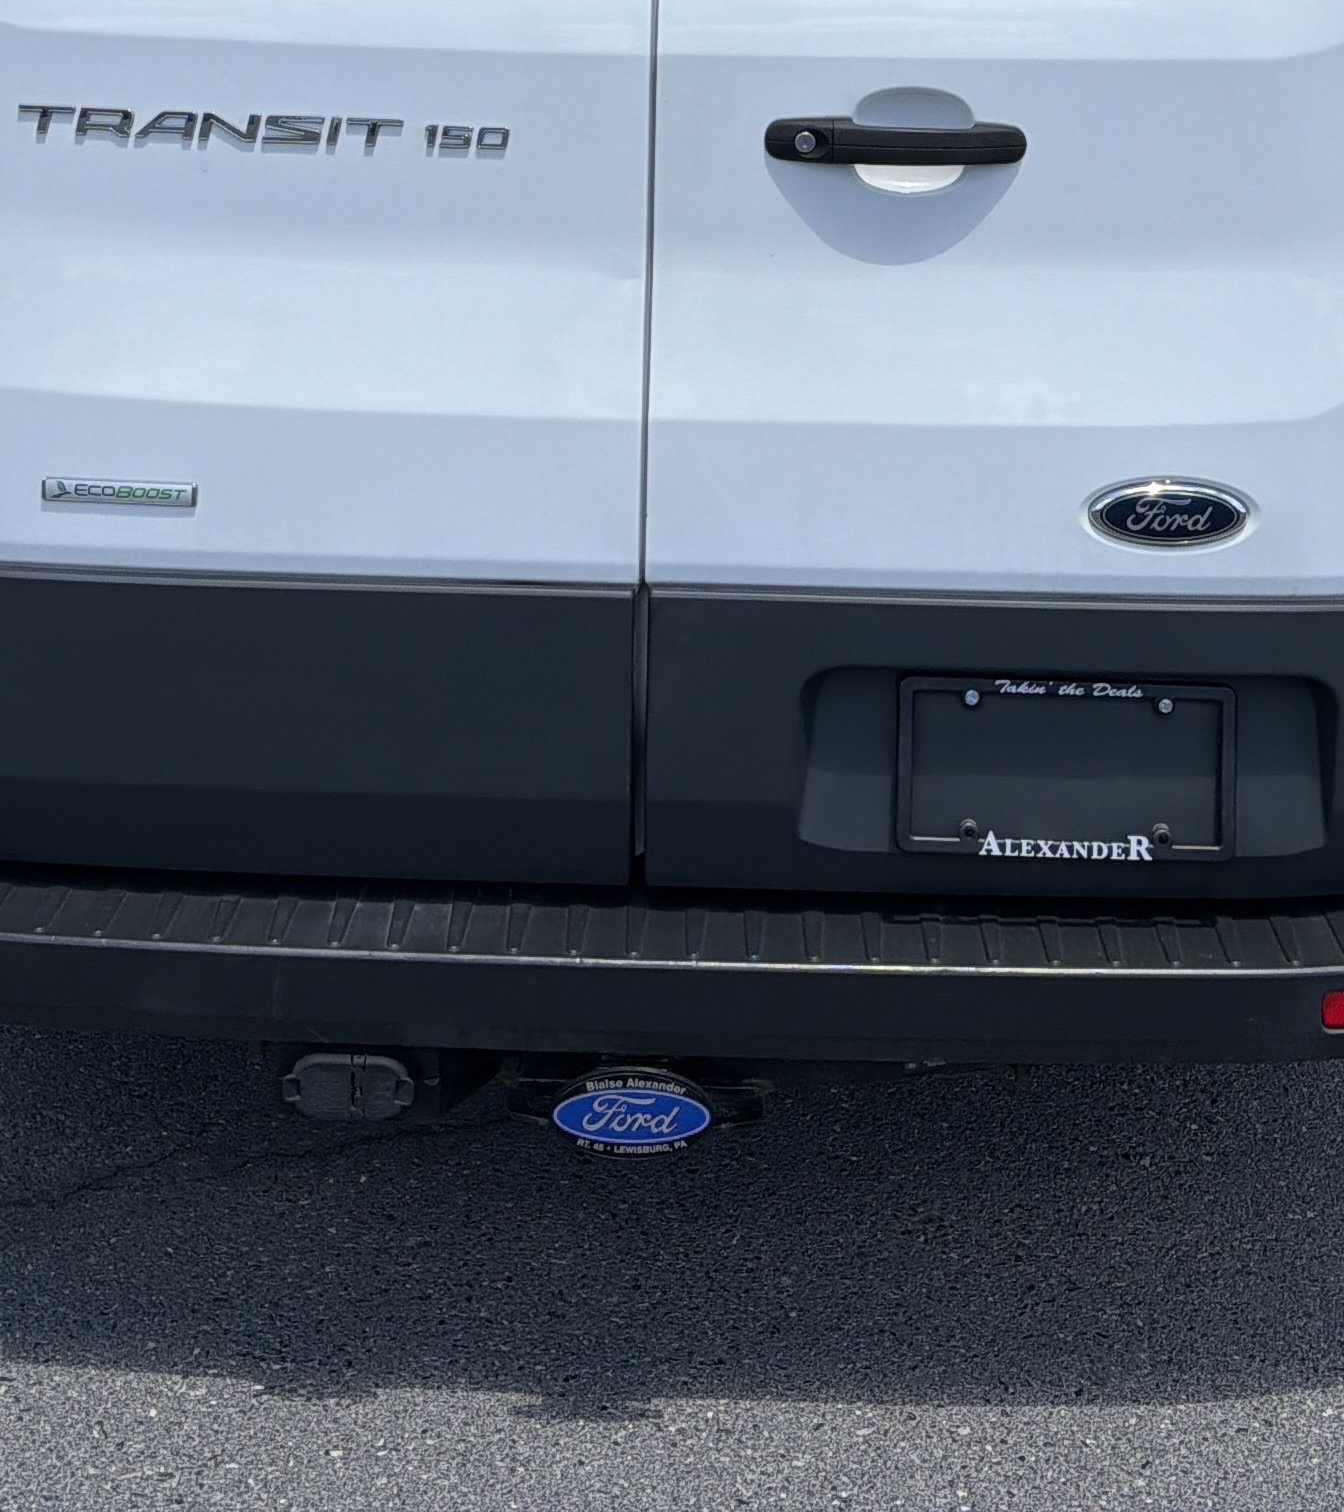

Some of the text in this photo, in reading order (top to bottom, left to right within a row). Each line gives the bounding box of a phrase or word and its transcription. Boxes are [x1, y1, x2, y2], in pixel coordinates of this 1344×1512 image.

[18, 104, 512, 153] TRANSIT 150
[1126, 497, 1214, 531] Ford
[994, 679, 1144, 698] Takin' the Deals
[586, 1077, 687, 1095] Blaise Alexander
[581, 1094, 681, 1134] Ford
[576, 1138, 591, 1150] RT.
[613, 1143, 673, 1155] LEWISBURG,
[674, 1139, 688, 1150] PA
